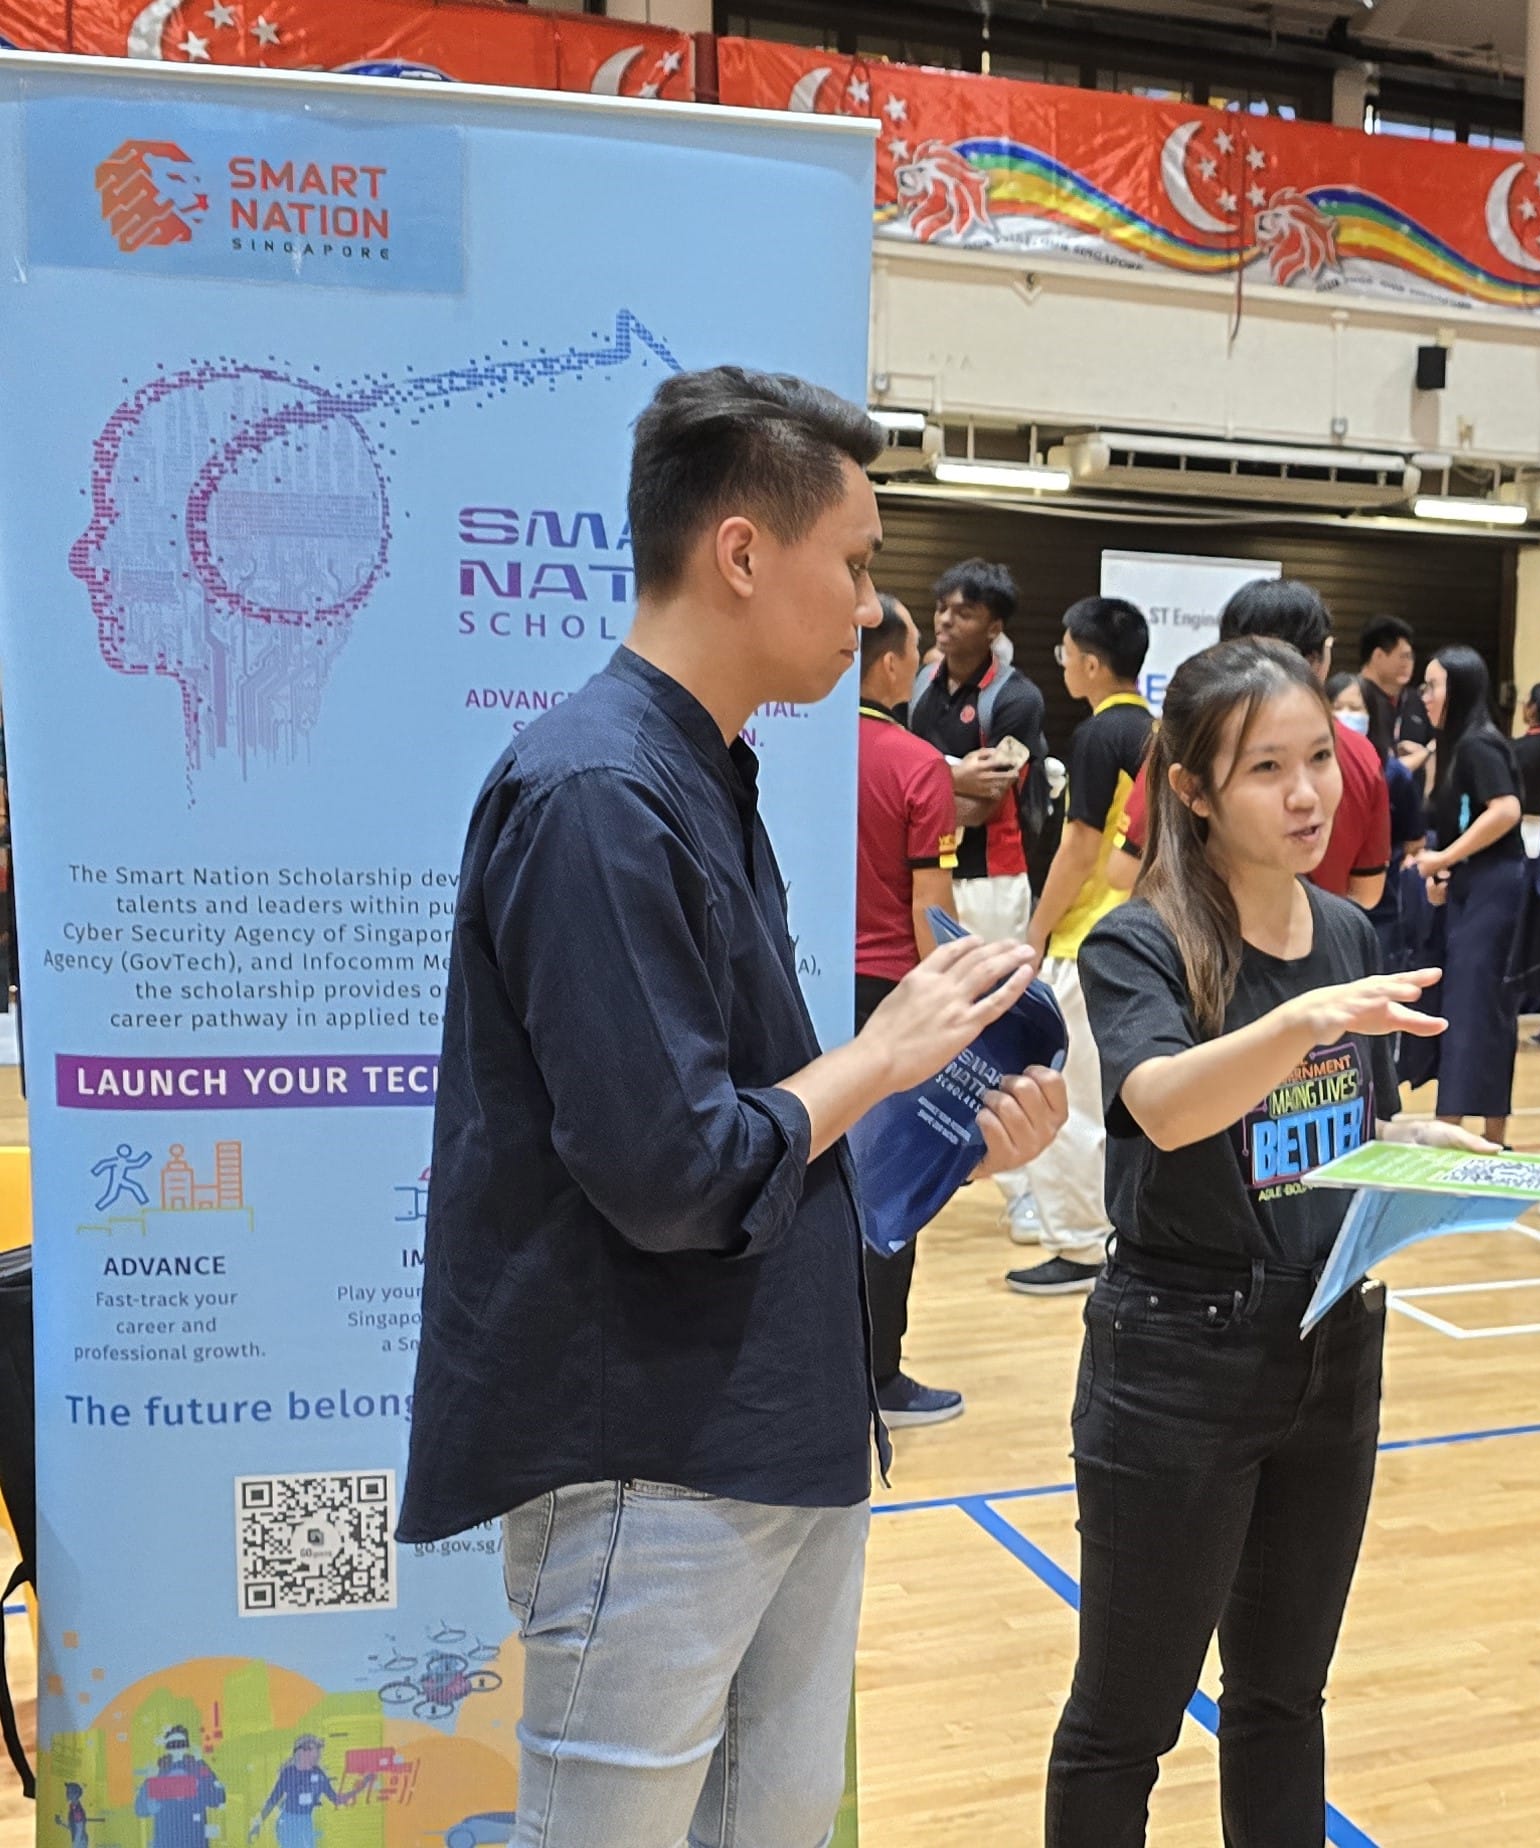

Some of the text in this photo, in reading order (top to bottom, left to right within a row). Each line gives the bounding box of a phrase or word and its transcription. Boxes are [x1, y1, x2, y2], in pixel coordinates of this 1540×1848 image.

[228, 156, 388, 200] SMART
[230, 198, 390, 240] NATION
[231, 237, 390, 261] SINGAPORE
[458, 610, 617, 640] SCHOL
[465, 688, 576, 711] ADVANC
[69, 864, 108, 884] The
[115, 865, 185, 886] Smart
[193, 866, 269, 886] Nation
[278, 867, 412, 891] Scholarship
[116, 895, 197, 914] talents
[206, 896, 248, 914] and
[258, 895, 343, 915] leaders
[351, 895, 419, 915] within
[63, 922, 124, 944] Cyber
[131, 923, 226, 947] Security
[234, 925, 315, 946] Agency
[323, 924, 348, 943] of
[43, 949, 113, 974] Agency
[121, 950, 242, 976] (GovTech),
[251, 952, 292, 971] and
[303, 952, 414, 972] Infocomm
[135, 982, 172, 1000] the
[181, 980, 315, 1001] scholarship
[324, 980, 421, 1001] provides
[110, 1010, 182, 1028] career
[192, 1008, 287, 1031] pathway
[296, 1008, 317, 1027] in
[326, 1007, 410, 1030] applied
[77, 1067, 227, 1098] LAUNCH
[243, 1066, 348, 1096] YOUR
[1318, 1070, 1358, 1105] LIVES
[1252, 1096, 1365, 1184] BETTER
[103, 1256, 227, 1277] ADVANCE
[96, 1291, 238, 1309] Fast-track your
[337, 1284, 376, 1303] Play
[116, 1317, 217, 1334] career and
[74, 1341, 267, 1363] professional growth.
[66, 1395, 131, 1426] The
[144, 1395, 272, 1427] future
